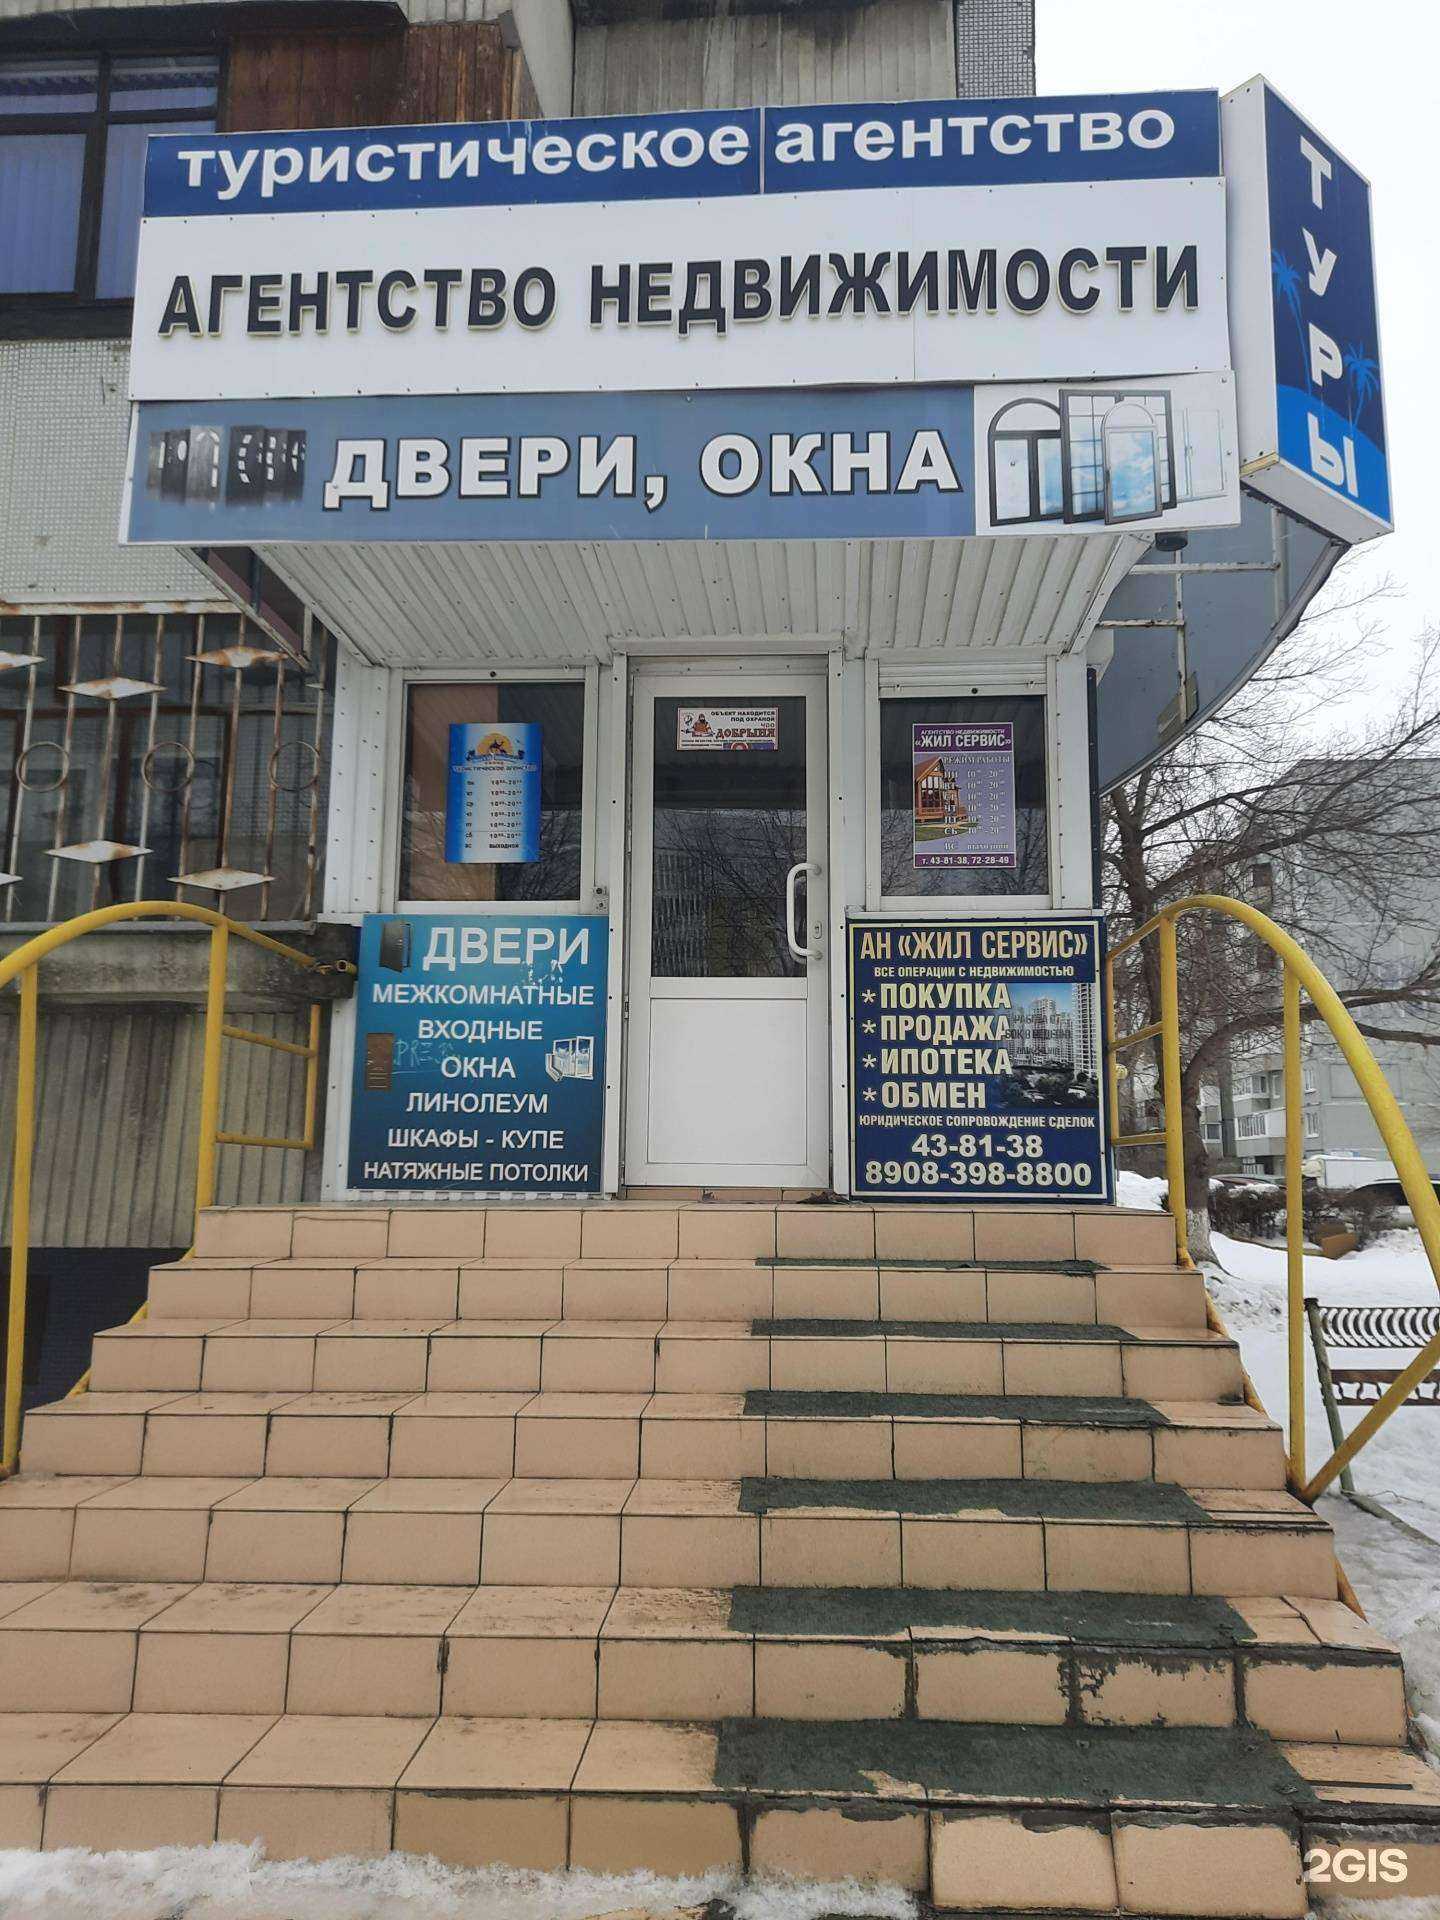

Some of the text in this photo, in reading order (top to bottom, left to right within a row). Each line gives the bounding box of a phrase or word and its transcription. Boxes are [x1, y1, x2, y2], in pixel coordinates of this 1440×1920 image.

[178, 108, 1175, 201] туристическое агентство
[158, 244, 1199, 338] АГЕНТСТВО НЕДВИЖИМОСТИ
[1299, 136, 1358, 498] ТУРЫ
[322, 429, 963, 513] ДВЕРИ, ОКНА
[716, 728, 775, 739] ДОБРЫНЯ
[930, 856, 969, 865] 43-81-38,
[972, 855, 1009, 864] 72-28-49
[423, 927, 589, 971] ДВЕРИ
[860, 930, 1088, 960] АН «ЖИЛ СЕРВИС»
[874, 966, 1074, 978] ВСЕ ОПЕРАЦИИ С НЕДВИЖИМОСТЬЮ
[372, 983, 594, 1005] МЕЖКОМНАТНЫЕ
[880, 982, 1012, 1009] ПОКУПКА
[419, 1020, 543, 1043] ВХОДНЫЕ
[880, 1015, 1011, 1046] ПРОДАЖА
[441, 1057, 516, 1078] ОКНА
[881, 1048, 1013, 1075] ИПОТЕКА
[406, 1093, 548, 1113] ЛИНОЛЕУМ
[881, 1081, 986, 1109] ОБМЕН
[859, 1114, 1095, 1128] ЮРИДИЧЕСКОЕ СОПРОВОЖДЕНИЕ СДЕЛОК
[388, 1129, 478, 1148] ШКАФЫ
[502, 1130, 564, 1149] КУПЕ
[911, 1134, 1043, 1158] 43-81-38
[364, 1161, 588, 1182] НАТЯЖНЫЕ ПОТОЛКИ
[865, 1161, 1092, 1186] 8908-398-8800
